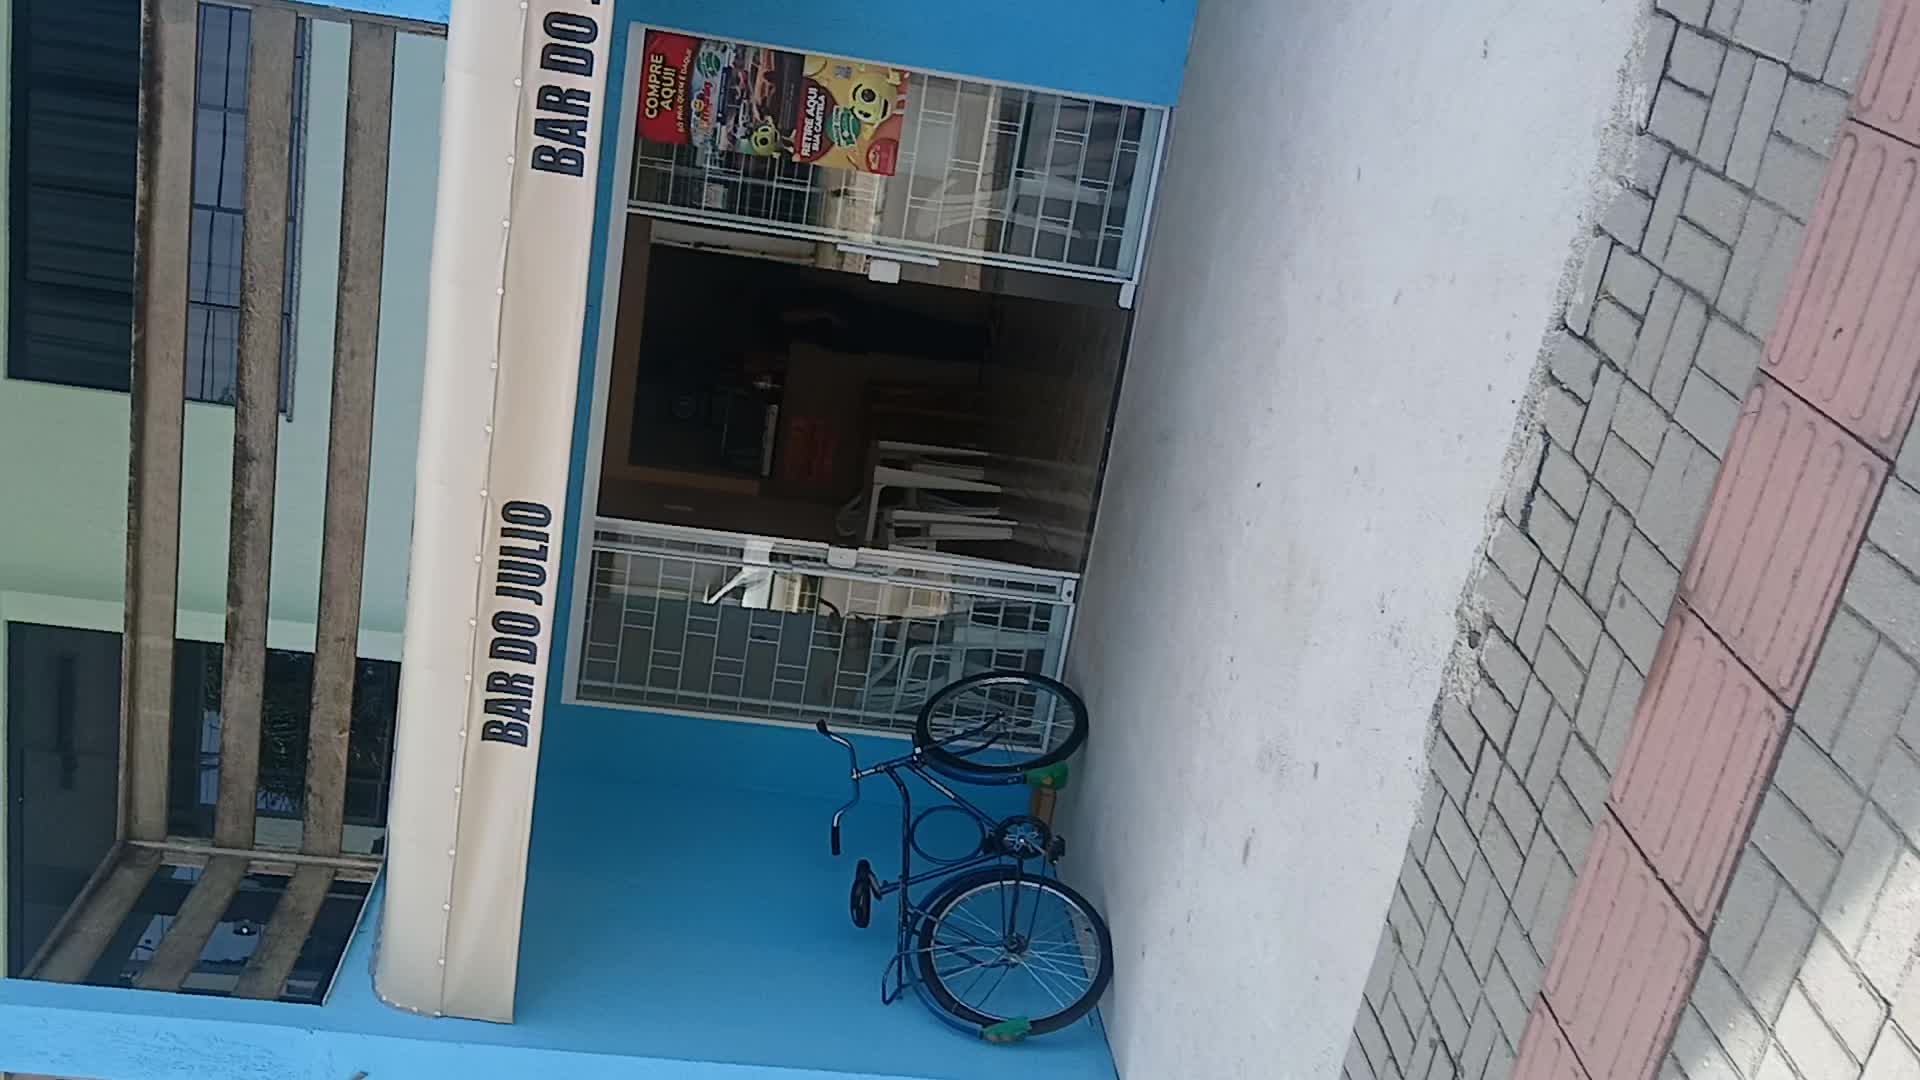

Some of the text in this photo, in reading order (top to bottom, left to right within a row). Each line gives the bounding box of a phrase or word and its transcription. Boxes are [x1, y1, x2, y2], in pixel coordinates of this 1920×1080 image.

[531, 11, 598, 177] BAR DO
[645, 54, 663, 118] COMPRE
[660, 67, 676, 110] AQUI!
[677, 82, 686, 103] QUEM
[676, 106, 684, 120] PRA
[801, 118, 814, 156] RETIRE
[812, 95, 826, 151] SUA CARTELA
[481, 500, 552, 747] BAR DO JULIO
